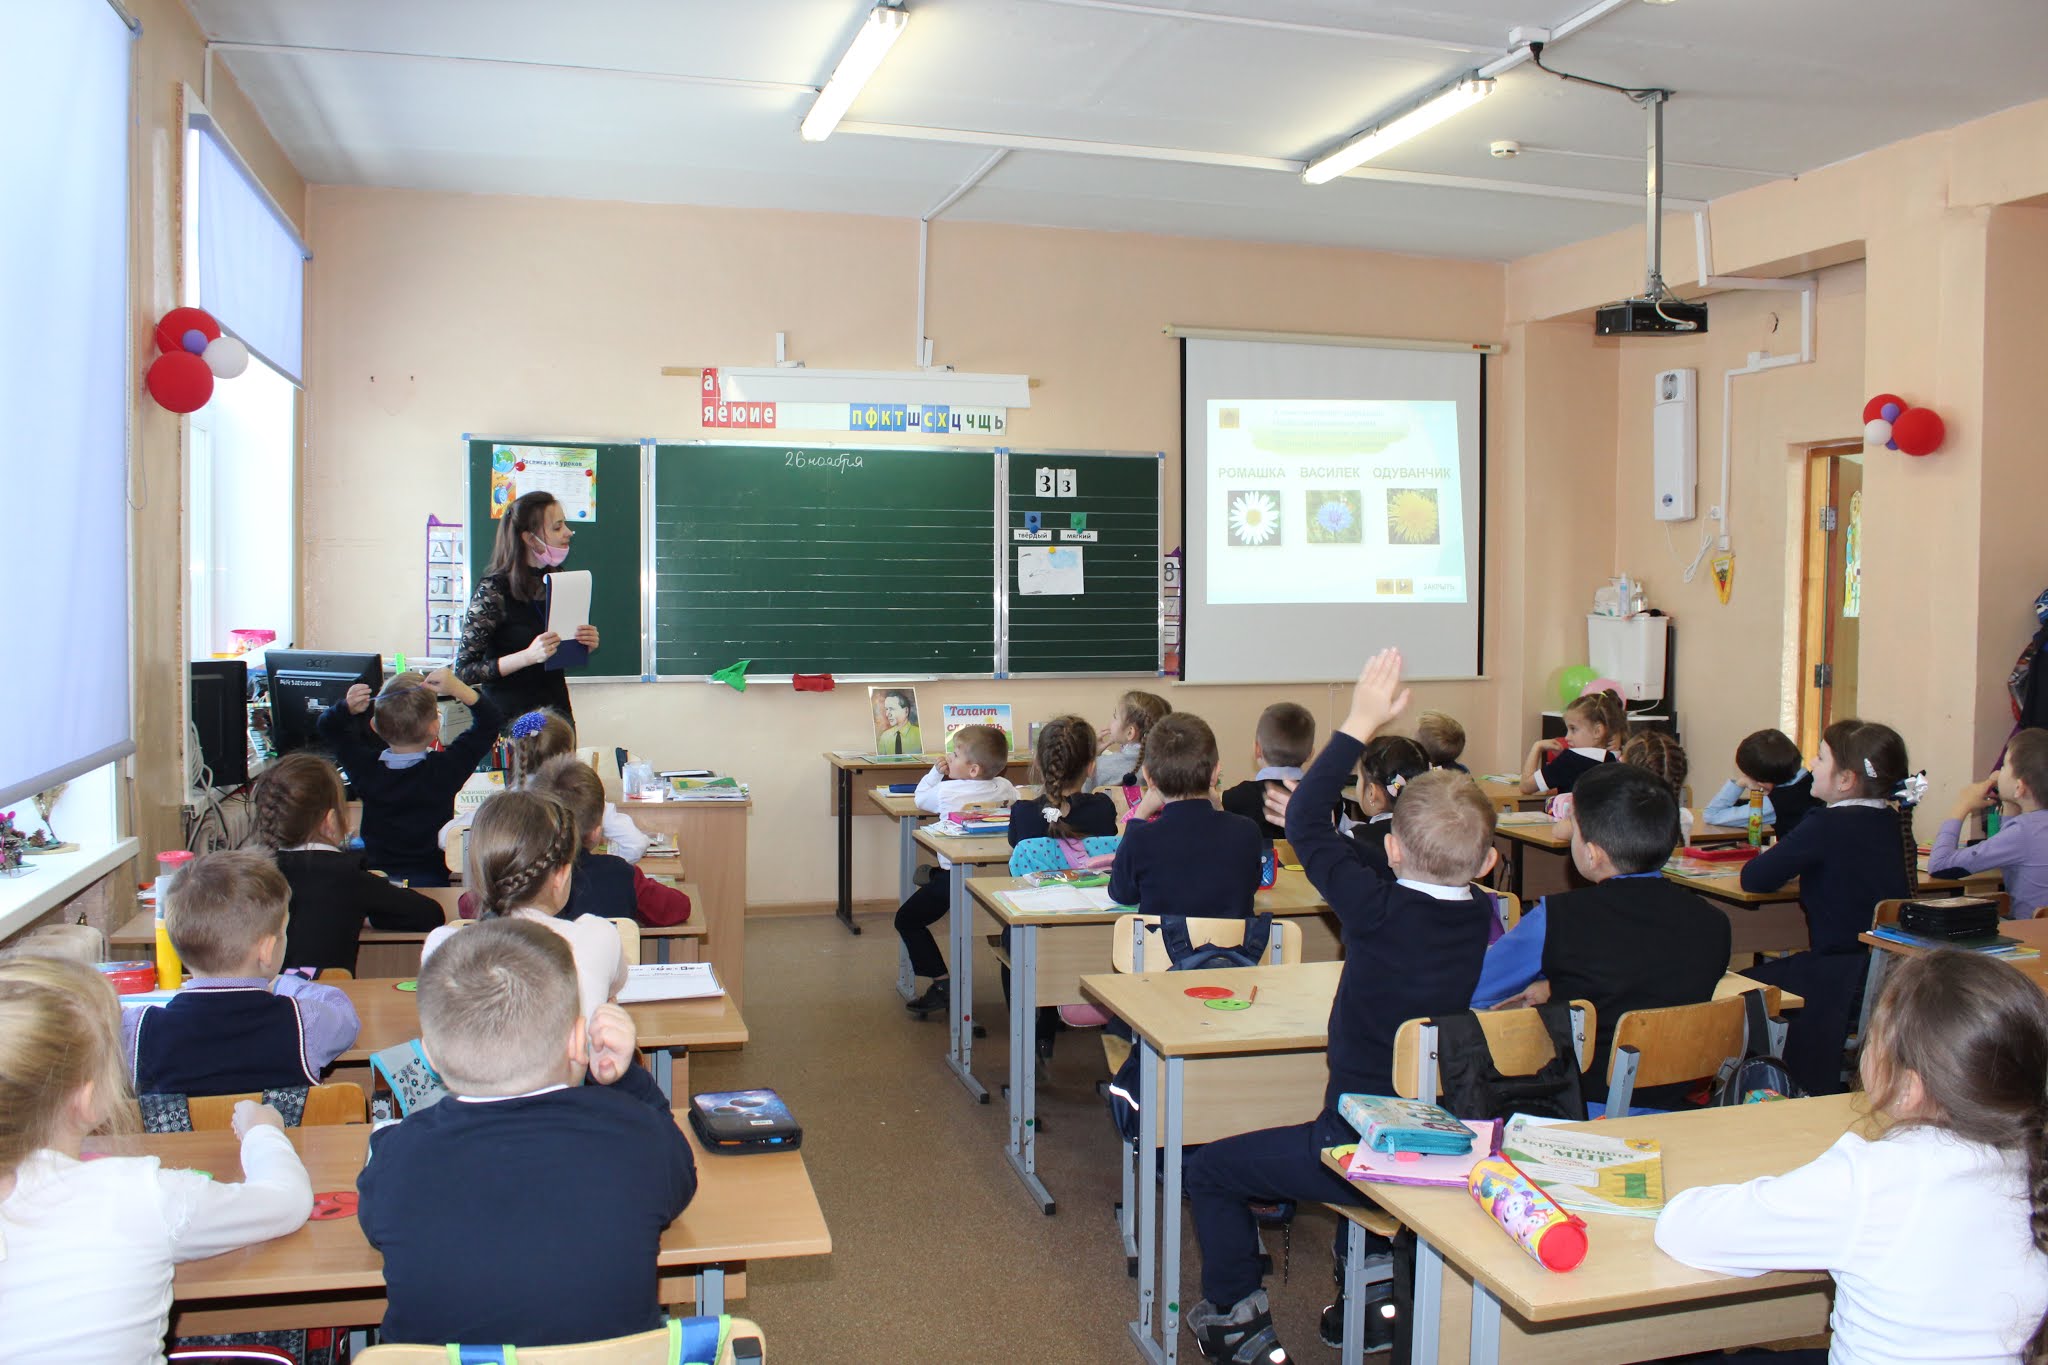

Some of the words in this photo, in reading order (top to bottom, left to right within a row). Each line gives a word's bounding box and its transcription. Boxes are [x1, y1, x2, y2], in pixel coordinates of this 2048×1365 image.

[785, 451, 806, 468] 26
[808, 453, 864, 474] ноября
[1218, 467, 1286, 478] РОМАШКА
[1300, 467, 1361, 478] ВАСИЛЕК
[1372, 467, 1451, 480] ОДУВАНЧИК
[950, 706, 998, 717] Талант
